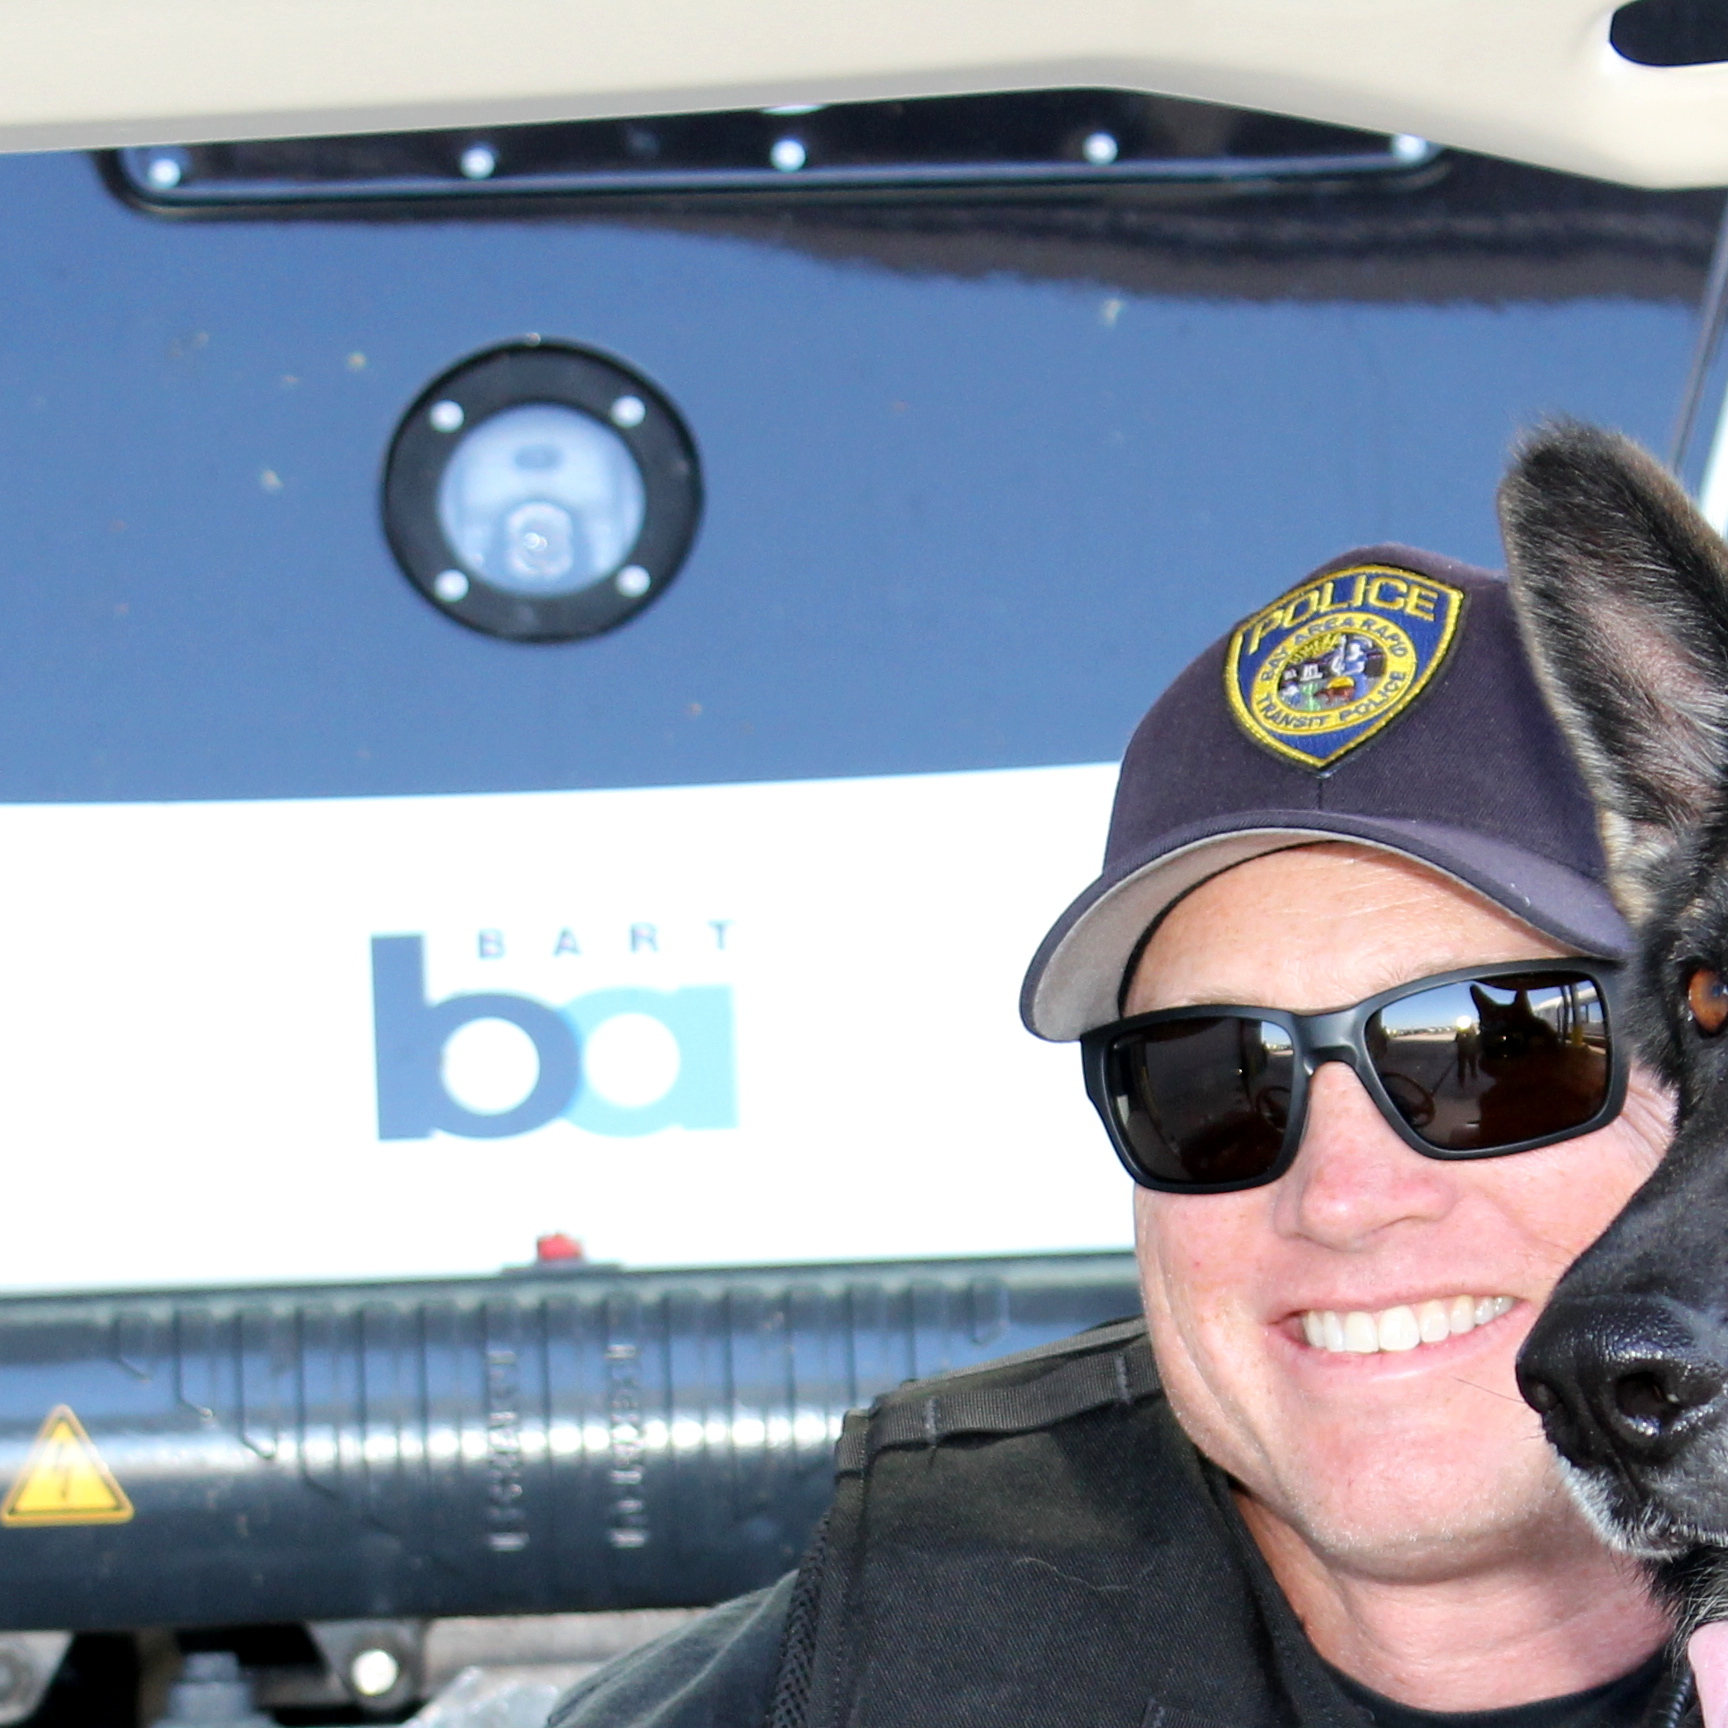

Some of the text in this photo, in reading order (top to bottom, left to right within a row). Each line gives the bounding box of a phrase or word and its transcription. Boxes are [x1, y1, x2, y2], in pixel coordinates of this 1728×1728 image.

[1248, 574, 1439, 655] POLICE
[1261, 616, 1408, 682] BAY AREA RAPID
[1256, 670, 1406, 729] TRANSIT POLICE
[478, 918, 735, 960] BART
